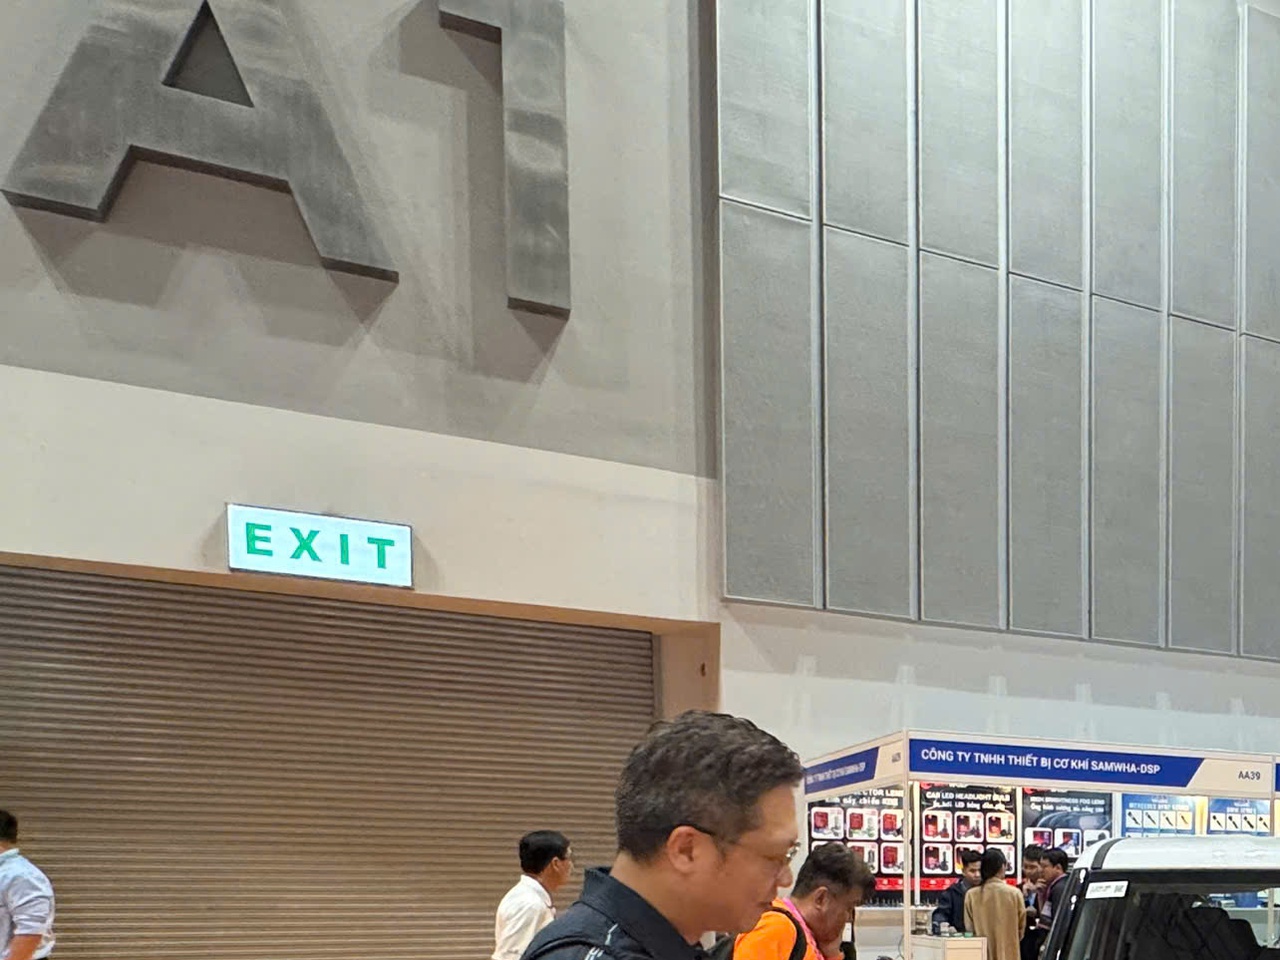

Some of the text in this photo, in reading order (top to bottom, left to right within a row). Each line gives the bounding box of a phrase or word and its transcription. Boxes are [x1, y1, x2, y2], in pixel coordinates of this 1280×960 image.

[244, 521, 396, 571] EXIT
[920, 746, 1161, 775] CÔNG TY TNHH THIẾT BỊ CƠ KHÍ SAMWHA-DSP
[1238, 770, 1261, 781] AA39
